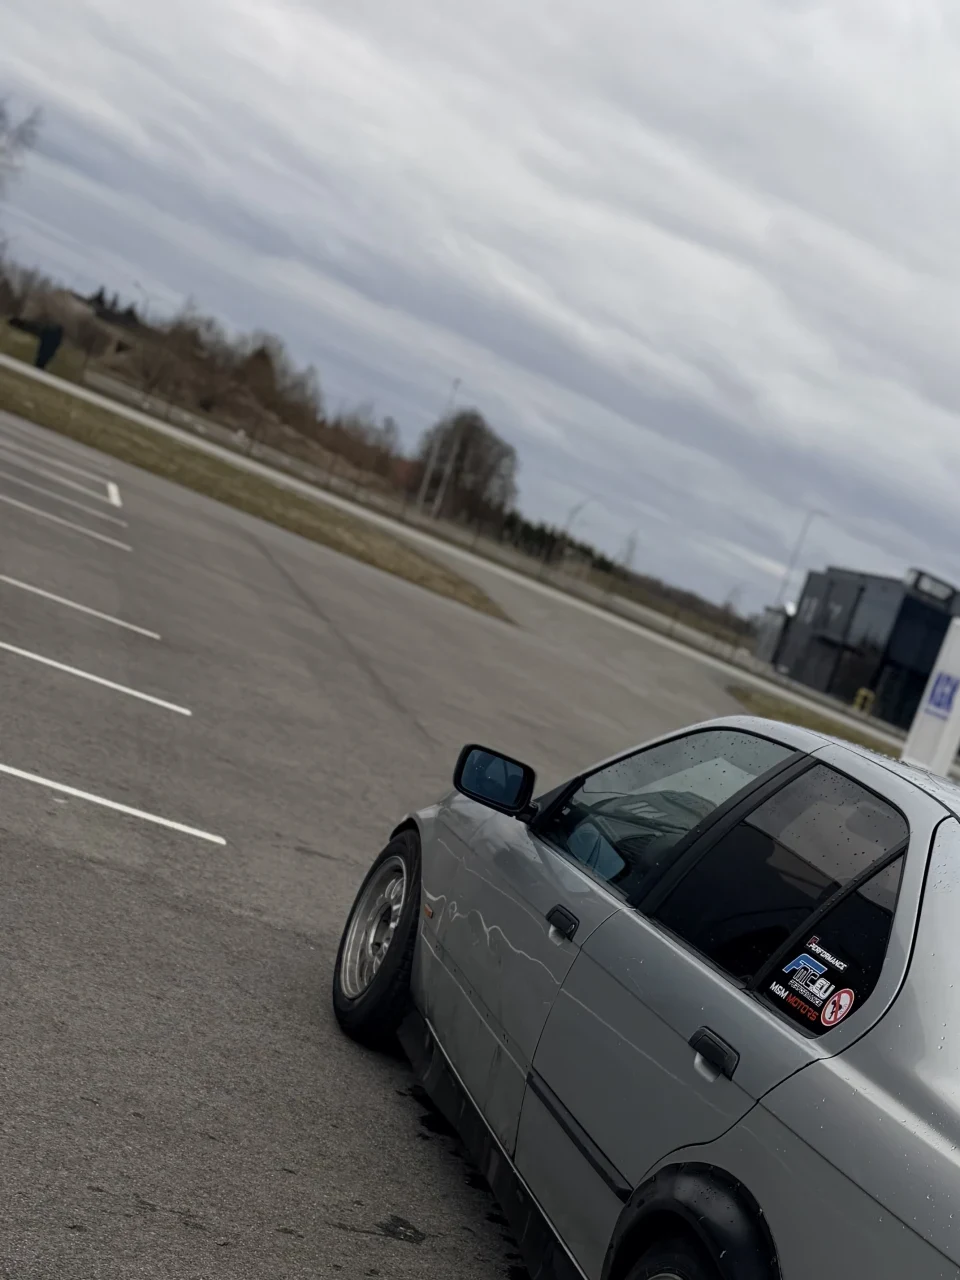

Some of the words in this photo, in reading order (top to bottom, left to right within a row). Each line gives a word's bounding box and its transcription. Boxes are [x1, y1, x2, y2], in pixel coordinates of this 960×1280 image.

[808, 943, 848, 971] PERFORMANCE
[769, 981, 789, 999] MSM
[786, 993, 819, 1021] MOTORS
